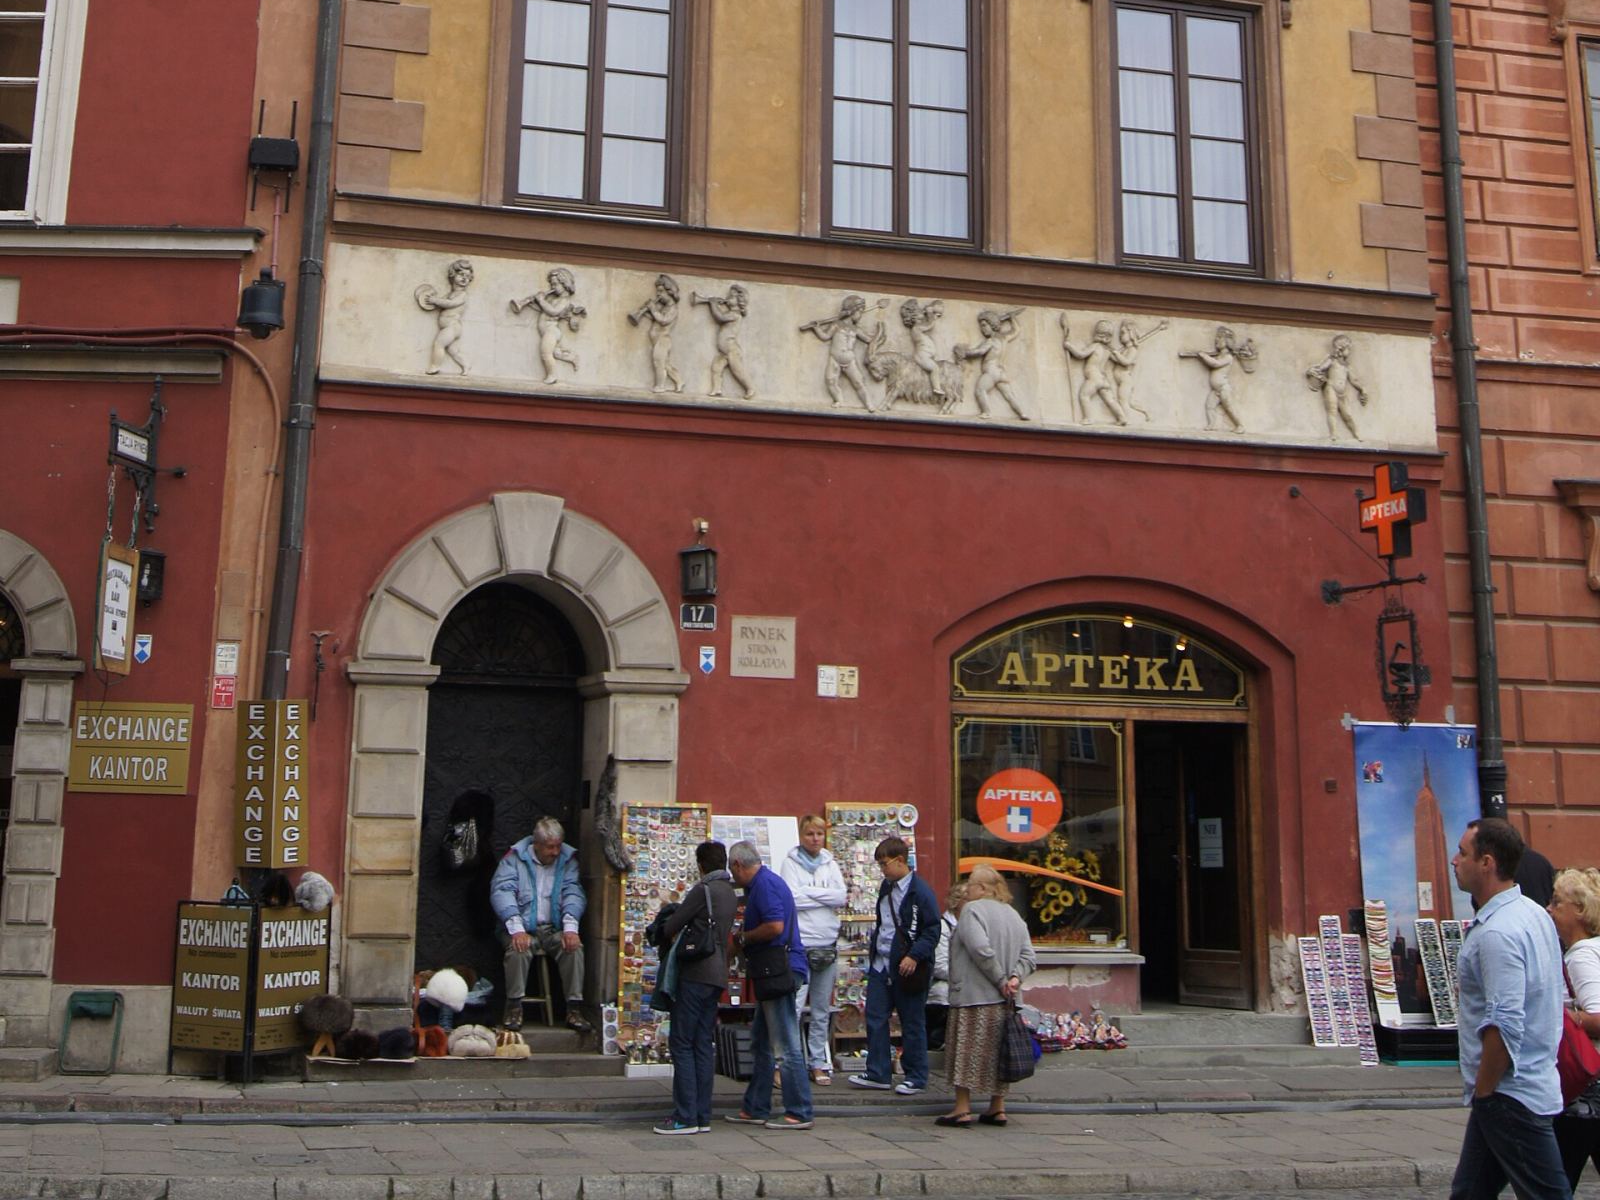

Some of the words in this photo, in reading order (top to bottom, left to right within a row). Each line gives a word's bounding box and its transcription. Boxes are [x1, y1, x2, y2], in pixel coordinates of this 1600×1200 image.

[1362, 498, 1408, 523] APTEKA
[691, 564, 702, 577] 17
[690, 606, 706, 622] 17
[740, 626, 788, 641] RYNEK
[997, 652, 1204, 692] APTEKA
[76, 715, 189, 742] EXCHANGE
[89, 755, 168, 781] KANTOR
[244, 704, 266, 863] EXCHANGE
[282, 704, 301, 863] EXCHANGE
[984, 788, 1057, 803] APTEKA
[180, 919, 249, 949] EXCHANGE
[261, 919, 328, 949] EXCHANGE
[182, 972, 241, 991] KANTOR
[264, 970, 321, 989] KANTOR
[176, 1005, 209, 1016] WALUTY
[212, 1007, 242, 1019] ŚWIATA
[258, 1005, 292, 1017] WALUTY
